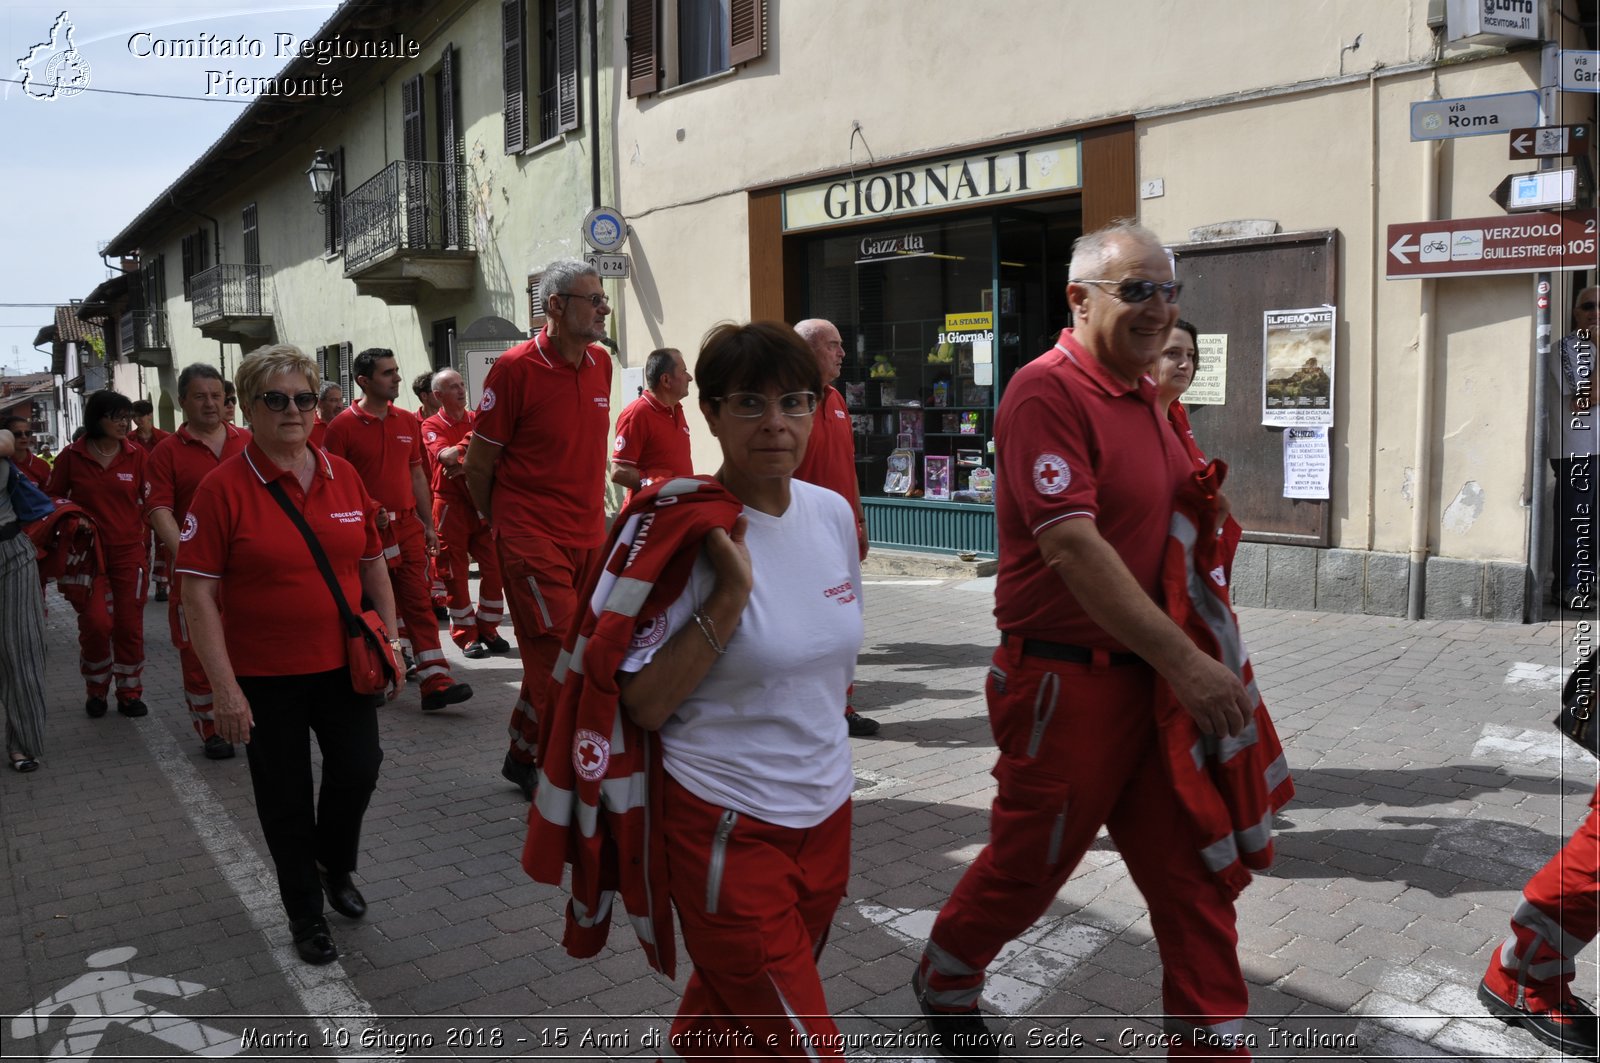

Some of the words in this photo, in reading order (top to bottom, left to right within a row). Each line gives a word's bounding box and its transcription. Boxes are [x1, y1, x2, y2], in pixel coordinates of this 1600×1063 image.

[1496, 0, 1532, 14] LOTTO
[1484, 16, 1518, 29] RICEVITORIA
[1574, 56, 1588, 66] via
[1449, 103, 1466, 113] via
[1448, 114, 1499, 128] Roma
[1575, 127, 1584, 137] 2
[824, 150, 1031, 220] GIORNALI
[1148, 182, 1156, 195] 2
[1485, 223, 1562, 240] VERZUOLO
[1584, 218, 1597, 234] 2
[1483, 244, 1547, 260] GUILLESTRE
[1547, 243, 1567, 257] (FR)
[1567, 239, 1595, 255] 105
[959, 318, 990, 326] STAMPA
[938, 332, 946, 344] il
[947, 329, 994, 344] Giornale
